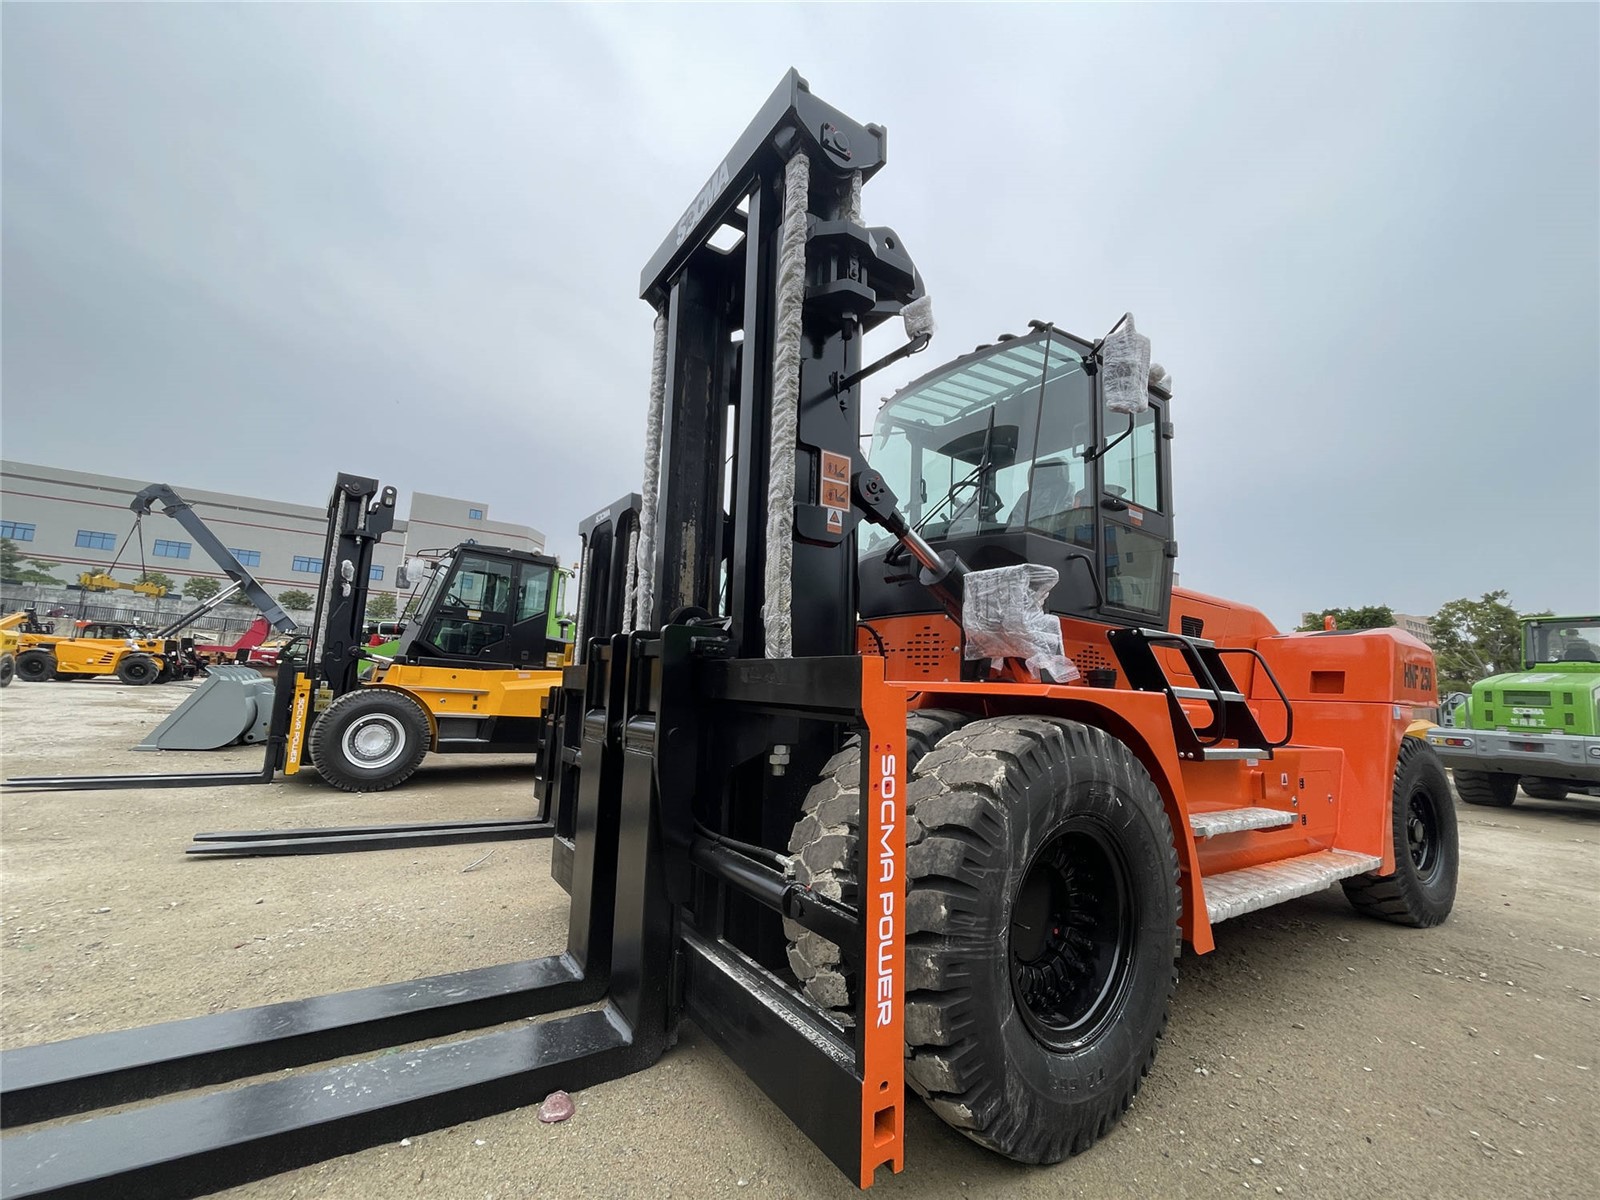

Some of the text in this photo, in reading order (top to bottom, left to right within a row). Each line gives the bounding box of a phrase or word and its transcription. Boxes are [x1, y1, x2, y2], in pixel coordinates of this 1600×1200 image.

[289, 731, 301, 763] POWER
[876, 754, 896, 1030] SOCMA POWER
